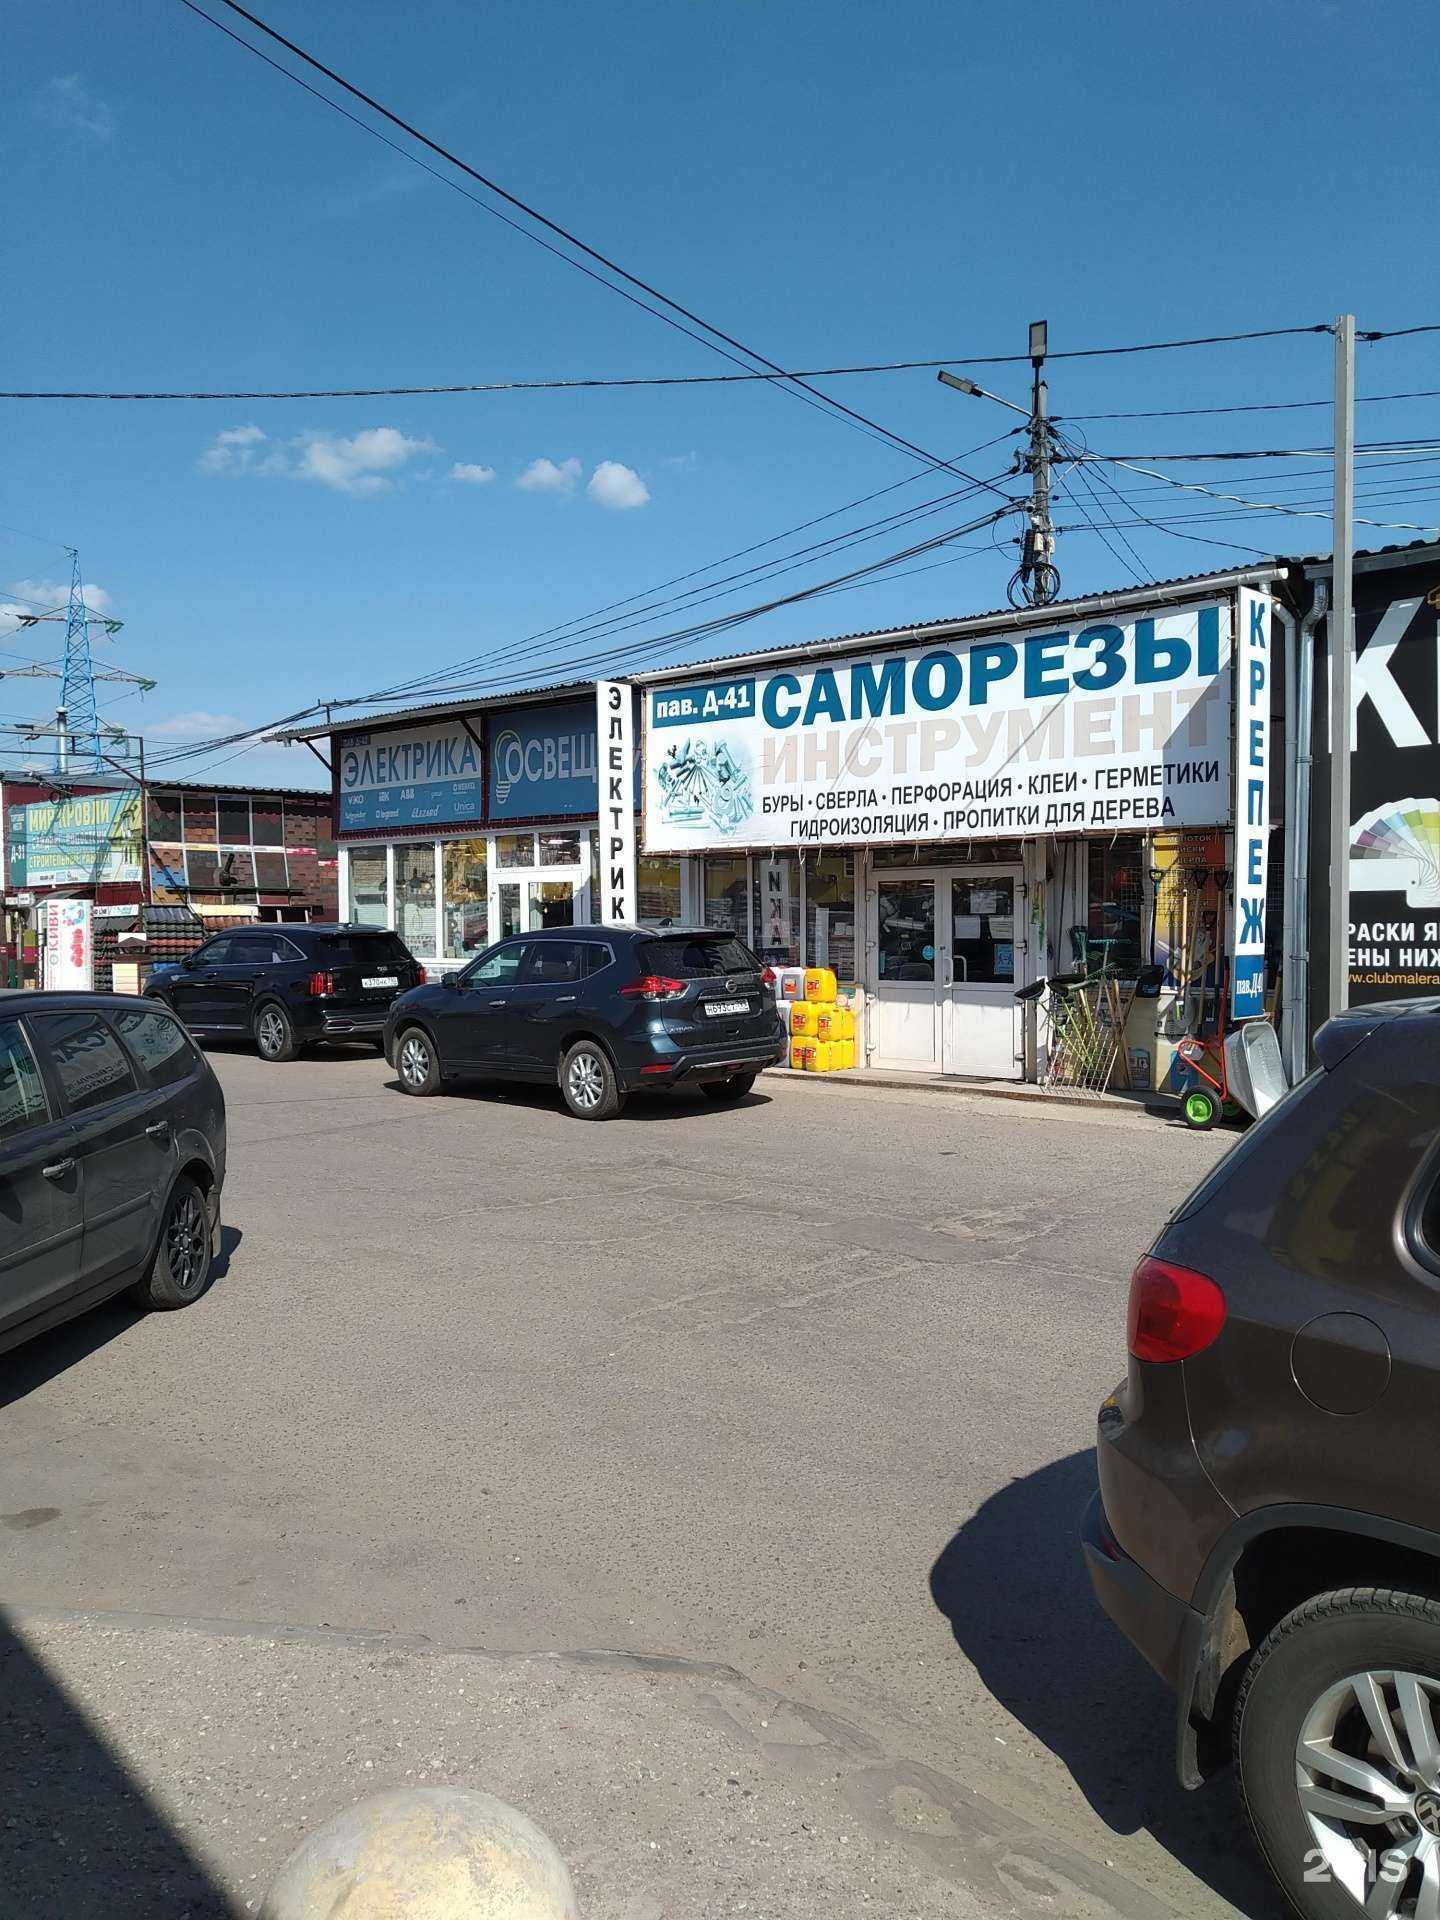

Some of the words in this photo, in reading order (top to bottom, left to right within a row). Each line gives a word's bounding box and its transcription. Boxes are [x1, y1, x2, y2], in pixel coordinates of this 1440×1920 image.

[657, 698, 698, 718] пав.
[703, 685, 750, 717] Д-41
[762, 606, 1219, 729] САМОРЕЗЫ
[1327, 597, 1440, 753] К
[344, 735, 477, 787] ЭЛЕКТРИКА
[762, 686, 1219, 785] ИНСТРУМЕНТ
[1239, 600, 1265, 944] КРЕПЕЖ
[608, 686, 625, 919] ЭЛЕКТРИК
[763, 795, 803, 813] БУРЫ
[816, 789, 878, 811] СВЕРЛА
[892, 778, 1012, 806] ПЕРФОРАЦИЯ
[1028, 772, 1077, 795] КЛЕИ
[1095, 761, 1219, 790] ГЕРМЕТИКИ
[791, 813, 929, 840] ГИДРОИЗОЛЯЦИЯ
[943, 805, 1039, 830] ПРОПИТКИ
[1045, 801, 1085, 827] ДЛЯ
[1091, 796, 1175, 825] ДЕРЕВА
